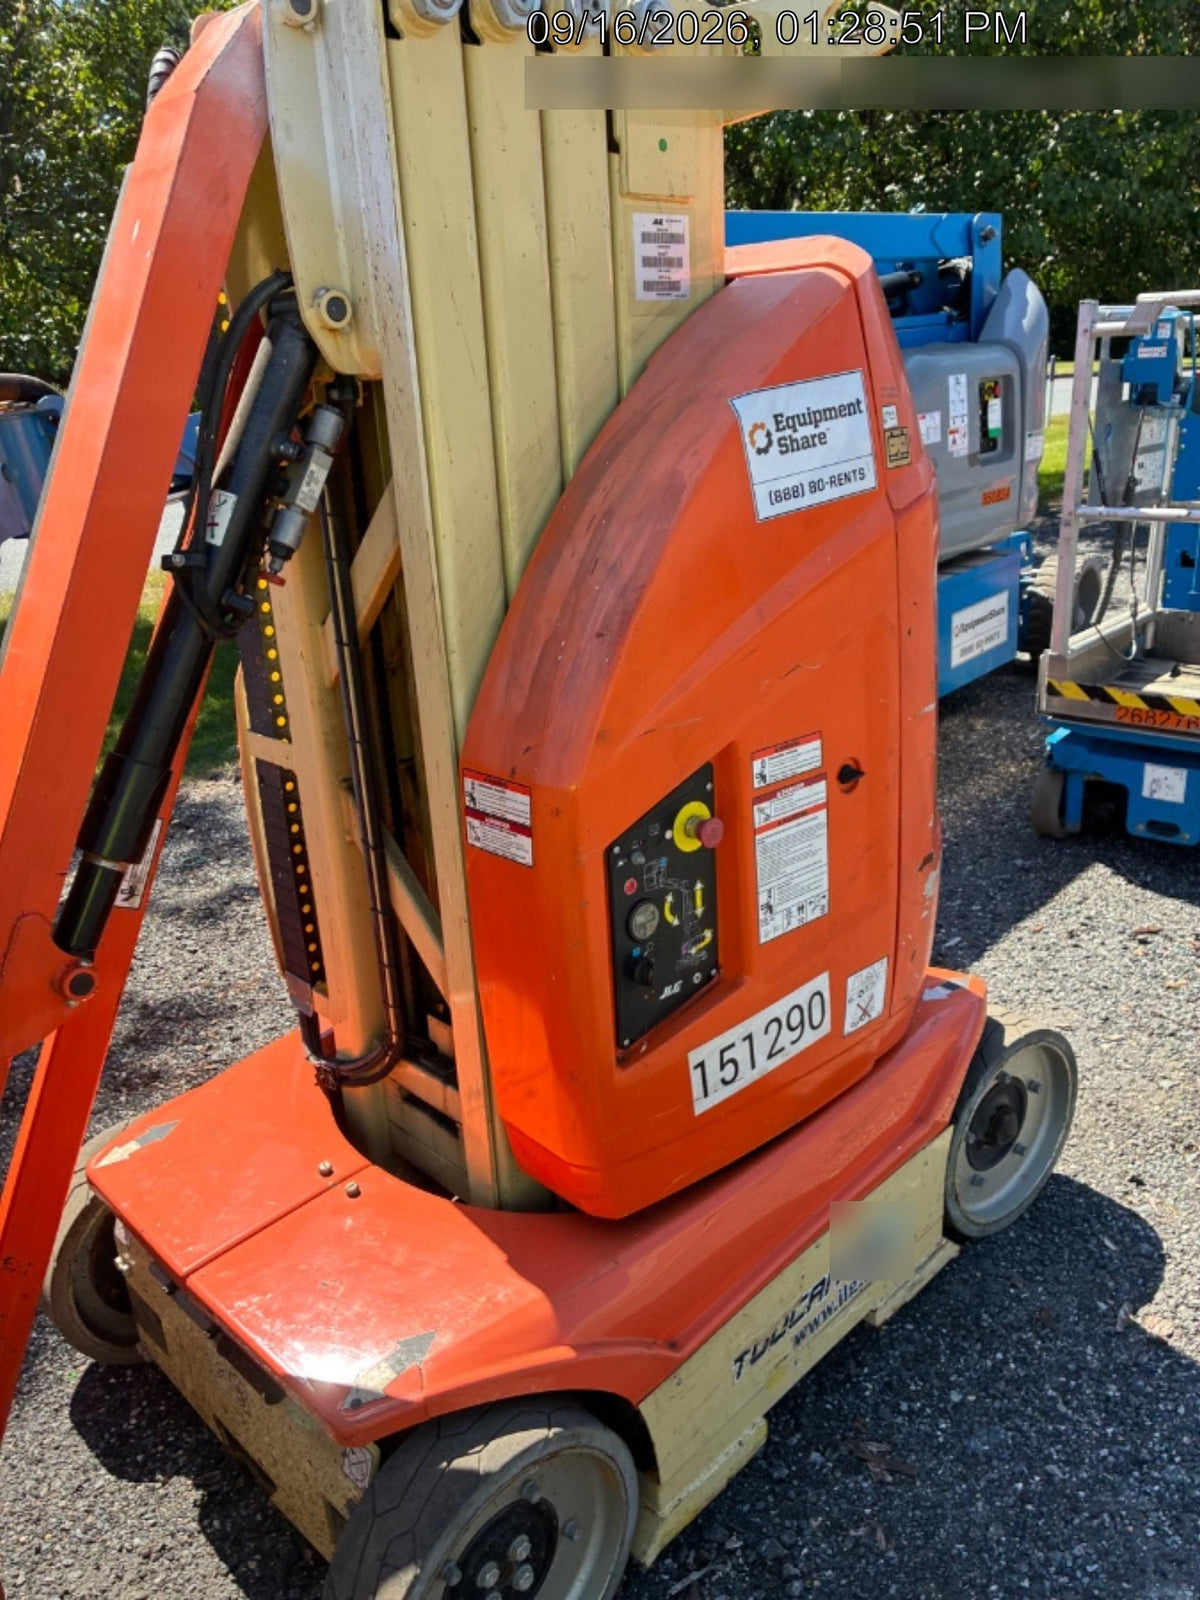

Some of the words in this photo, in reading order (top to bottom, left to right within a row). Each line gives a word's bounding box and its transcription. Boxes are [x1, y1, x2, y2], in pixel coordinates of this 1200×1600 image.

[773, 398, 864, 433] Equipment
[768, 482, 805, 506] (888)
[809, 467, 866, 495] 80-RENTS
[693, 990, 826, 1099] 151290
